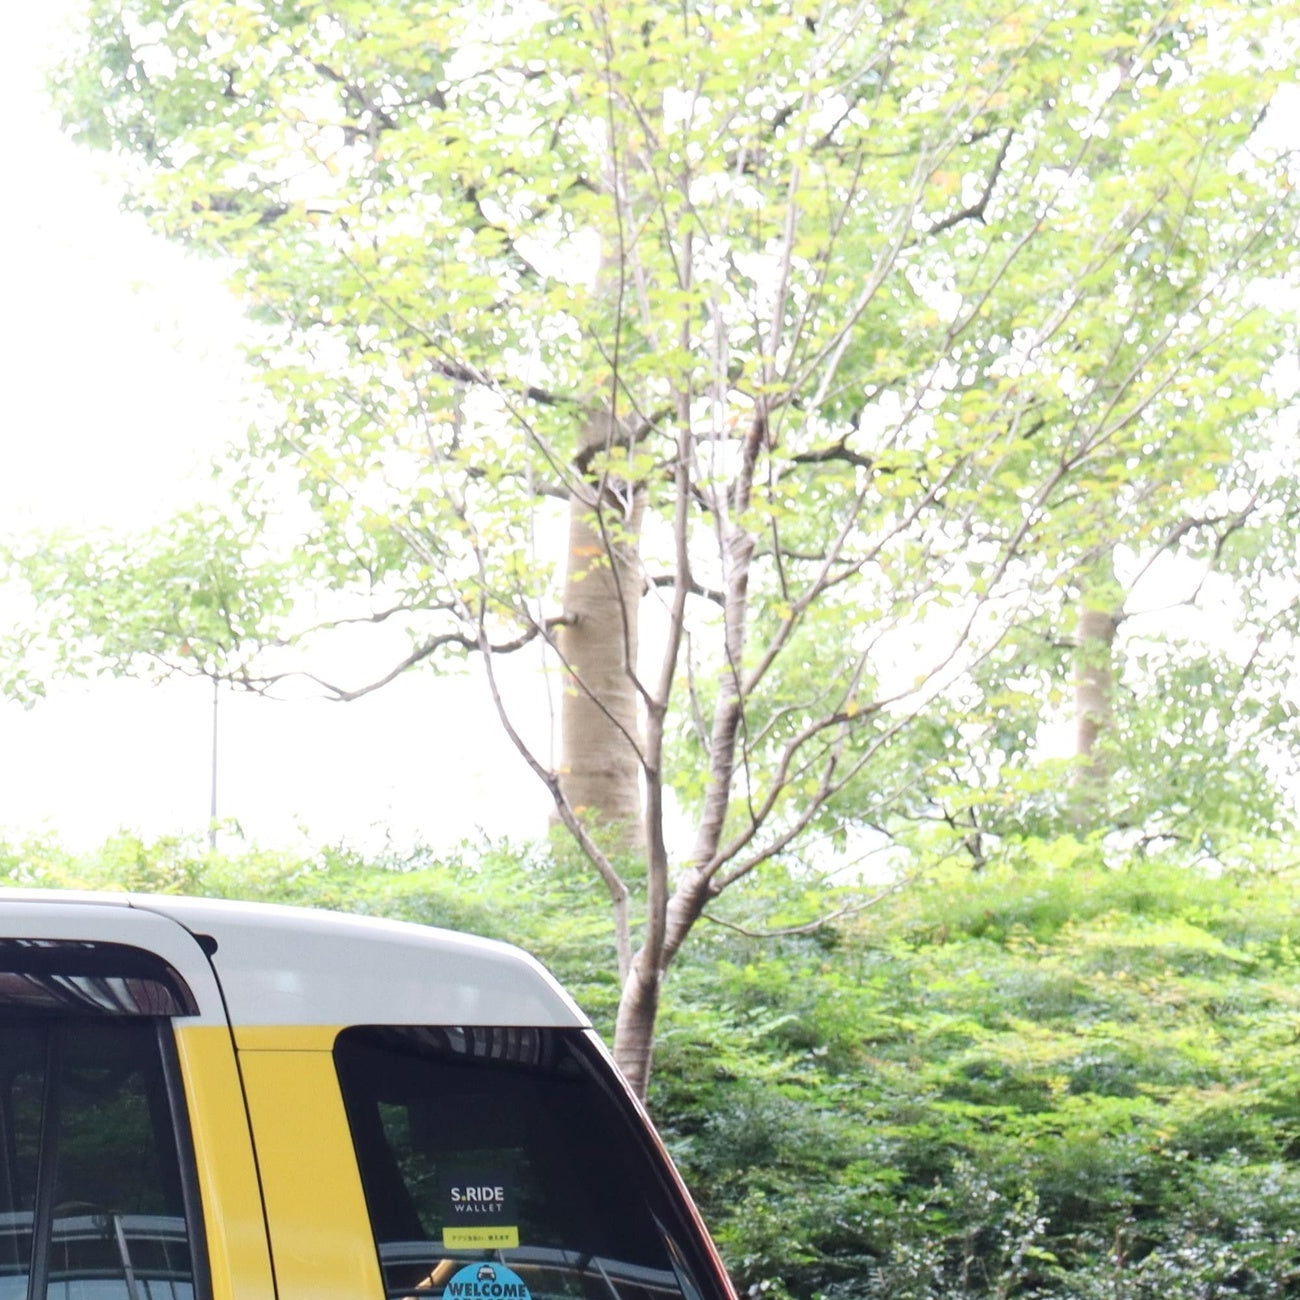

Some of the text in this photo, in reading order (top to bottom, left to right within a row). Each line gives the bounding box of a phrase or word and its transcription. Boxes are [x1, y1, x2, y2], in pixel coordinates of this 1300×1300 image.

[450, 1186, 505, 1202] S.RIDE
[454, 1203, 503, 1213] WALLET
[448, 1283, 527, 1297] WELCOME
